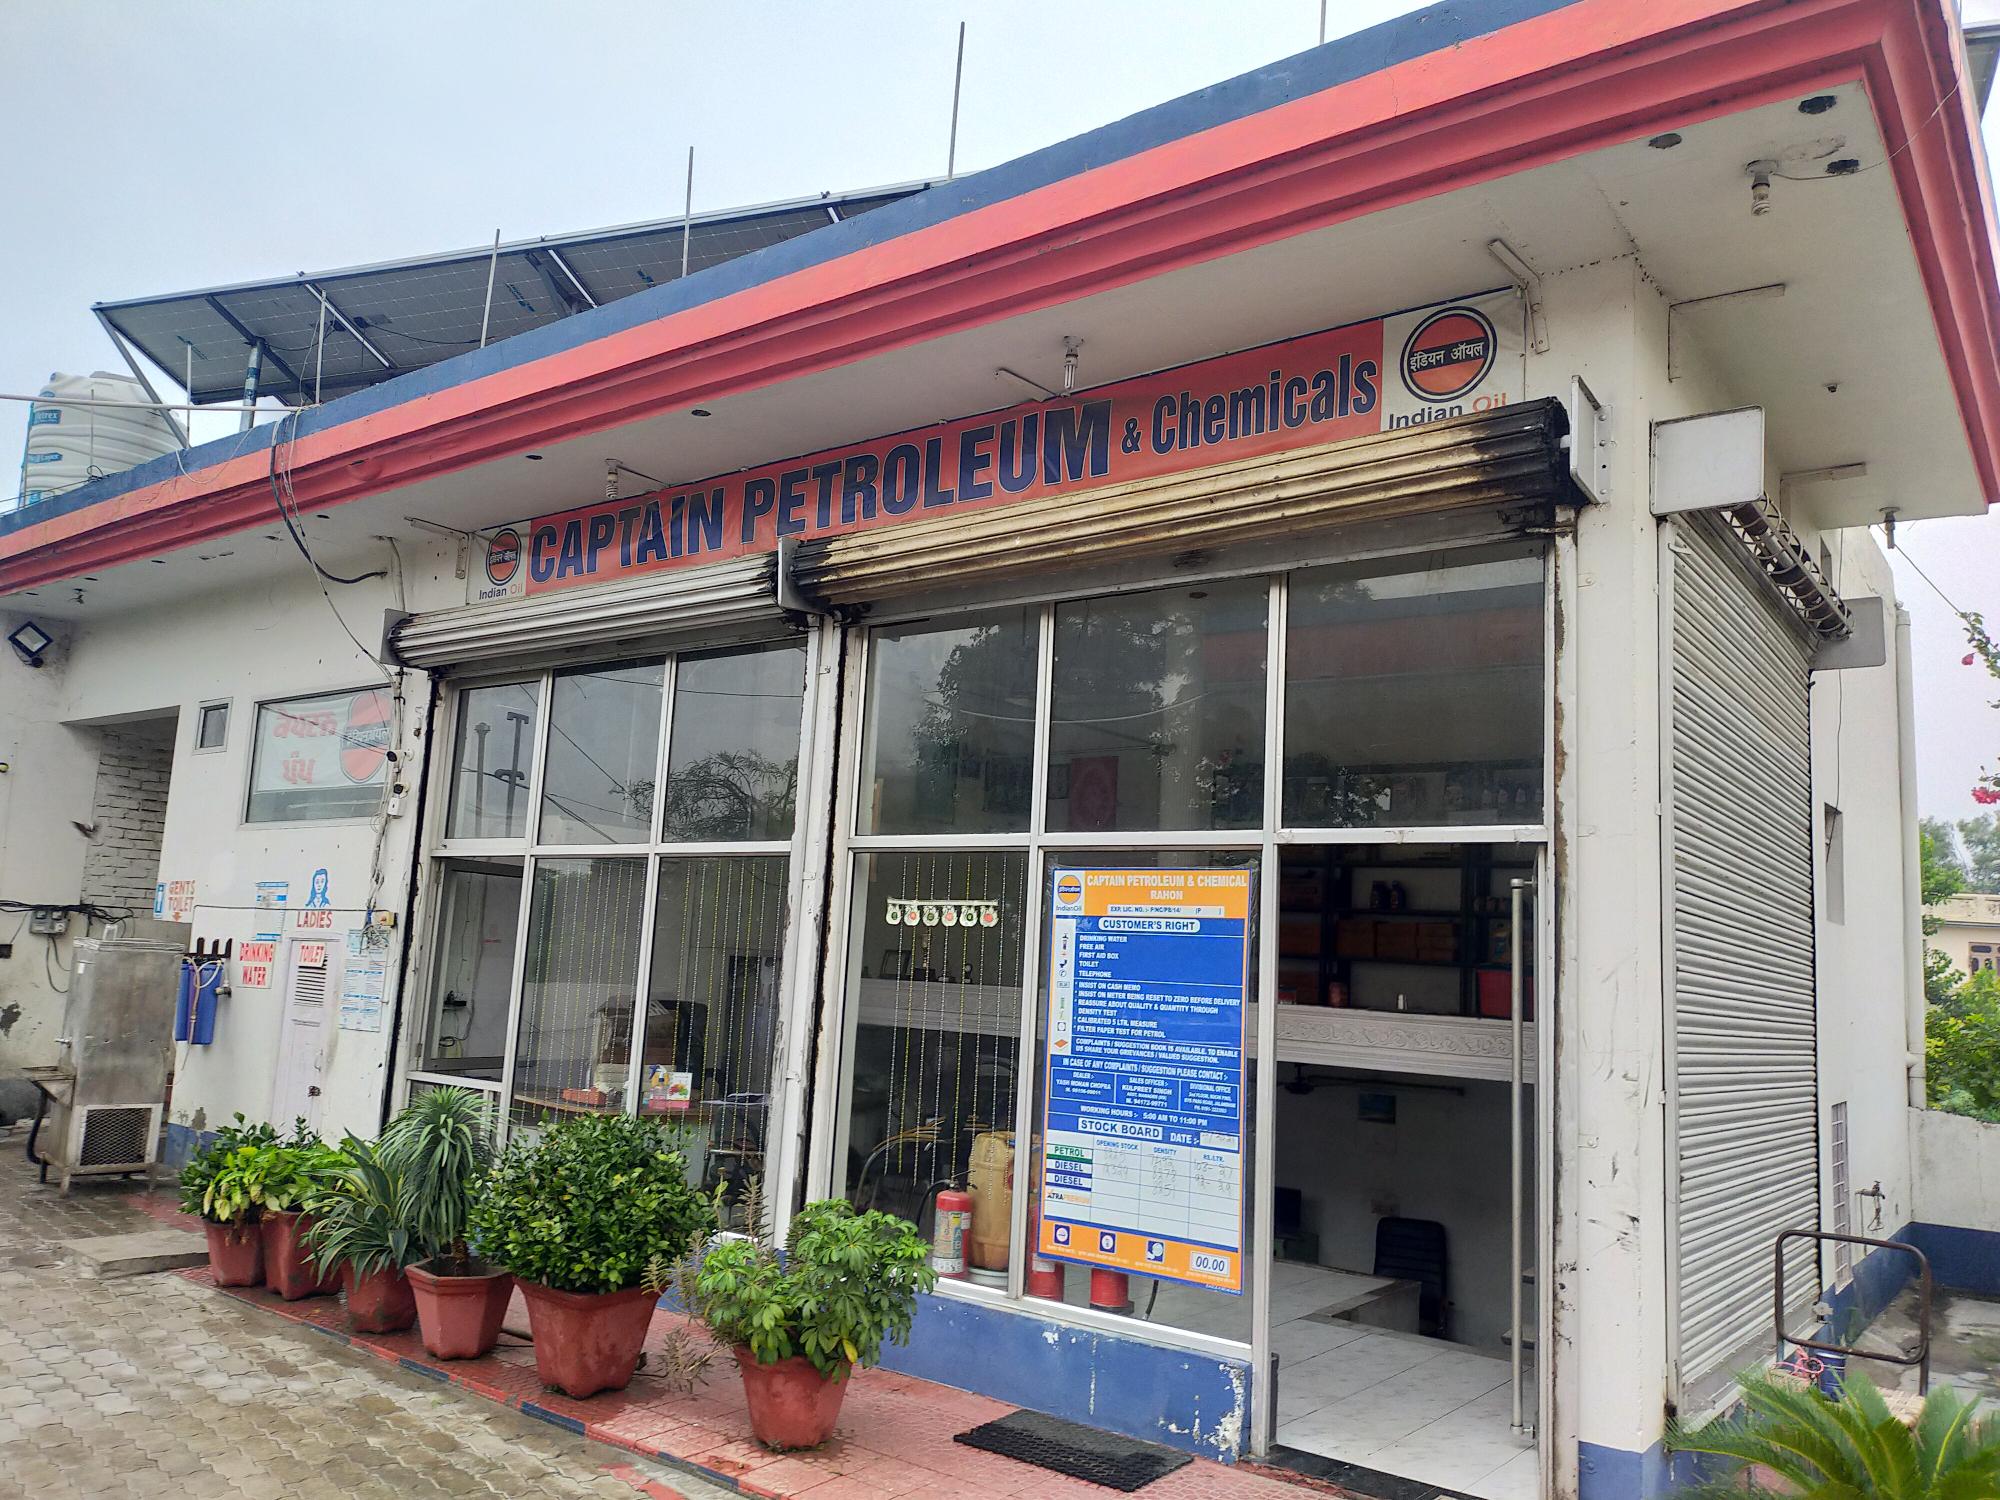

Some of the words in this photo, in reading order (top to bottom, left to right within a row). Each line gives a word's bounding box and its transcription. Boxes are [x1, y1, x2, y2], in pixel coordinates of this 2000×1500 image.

[1409, 350, 1444, 372] इंडियन
[1450, 341, 1485, 361] ऑयल
[1389, 405, 1463, 430] Indian
[1472, 393, 1507, 414] Oil
[530, 487, 726, 584] CAPTAIN
[741, 400, 1113, 545] PETROLEUM
[1121, 417, 1143, 456] &
[1151, 353, 1378, 456] Chemicals
[479, 588, 507, 600] Indian
[510, 584, 523, 595] Oil
[169, 880, 195, 895] GENTS
[1087, 875, 1124, 886] CAPTAIN
[1127, 875, 1185, 887] PETROLEUM
[1187, 875, 1195, 887] &
[1197, 874, 1248, 887] CHEMICAL
[1150, 890, 1184, 900] RAHON
[168, 896, 194, 912] TOILET
[296, 911, 333, 928] LADIES
[1103, 919, 1162, 930] CUSTOMER'S
[1165, 921, 1196, 931] RIGHT
[240, 943, 273, 962] DRINKING
[300, 945, 324, 963] TOILET
[242, 966, 266, 985] WATER
[1079, 970, 1112, 978] TELEPHONE
[1079, 981, 1097, 989] INSIST
[1078, 990, 1097, 998] INSIST
[1145, 994, 1164, 1002] RESET
[1173, 995, 1189, 1003] ZERO
[1190, 996, 1213, 1004] BEFORE
[1213, 998, 1240, 1006] DELIVERY
[1078, 999, 1107, 1007] REASSURE
[1107, 1000, 1127, 1008] ABOUT
[1128, 1002, 1153, 1010] QUALITY
[1160, 1003, 1189, 1012] QUANTITY
[1190, 1006, 1219, 1014] THROUGH
[1078, 1007, 1102, 1015] DENSITY
[1077, 1016, 1112, 1025] CALIBRATED
[1130, 1020, 1158, 1028] MEASURE
[1077, 1025, 1096, 1033] FILTER
[1096, 1026, 1115, 1034] PAPER
[1062, 1058, 1070, 1066] IN
[1070, 1058, 1085, 1067] CASE
[1084, 1060, 1092, 1068] OF
[1092, 1060, 1104, 1069] ANY
[1104, 1061, 1138, 1072] COMPLAINTS
[1141, 1064, 1177, 1076] SUGGESTION
[1177, 1067, 1198, 1078] PLEASE
[1198, 1069, 1224, 1081] CONTACT
[1073, 1071, 1091, 1079] DEALER
[1080, 1105, 1110, 1115] WORKING
[1110, 1108, 1133, 1117] HOURS
[1157, 1113, 1168, 1121] AM
[1168, 1114, 1178, 1122] TO
[1197, 1118, 1208, 1126] PM
[1081, 1119, 1118, 1134] STOCK
[1121, 1124, 1160, 1138] BOARD
[1096, 1139, 1120, 1148] OPENING
[1120, 1142, 1139, 1150] STOCK
[1170, 1132, 1192, 1144] DATE
[1054, 1146, 1085, 1158] PETROL
[1153, 1146, 1177, 1156] DENSITY
[1055, 1161, 1084, 1172] DIESEL
[1054, 1174, 1084, 1186] DIESEL
[1195, 1256, 1225, 1272] 00.00
